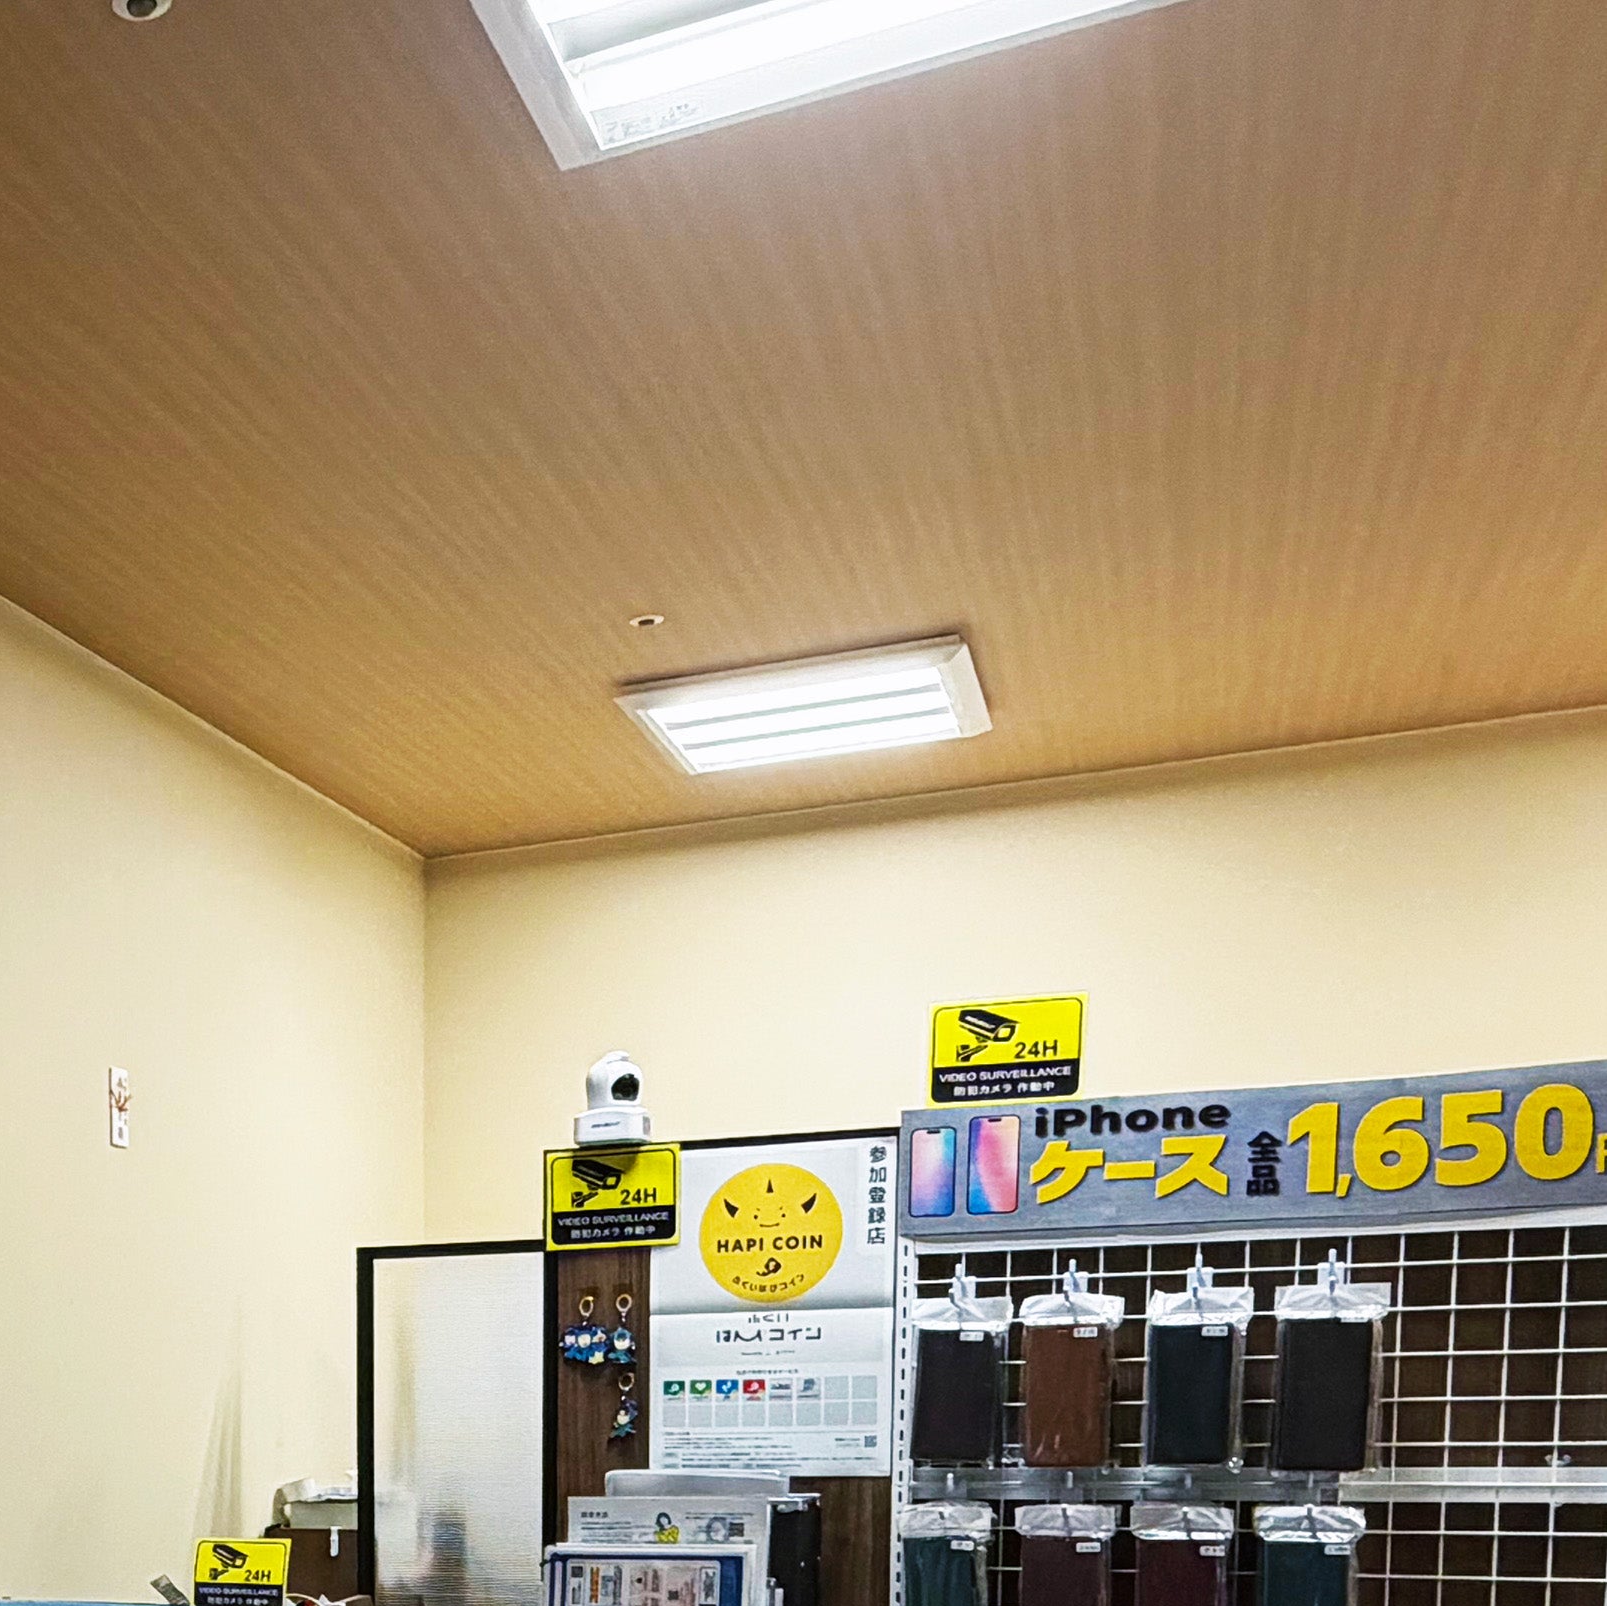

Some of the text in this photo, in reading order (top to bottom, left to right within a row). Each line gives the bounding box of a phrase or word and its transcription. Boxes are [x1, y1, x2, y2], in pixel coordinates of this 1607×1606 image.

[1015, 1039, 1058, 1059] 24H
[939, 1065, 1071, 1083] VIDEO SURVEILLANCE
[1035, 1101, 1232, 1138] iPhone
[1030, 1135, 1229, 1205] ケース
[1246, 1131, 1281, 1198] 全品
[620, 1188, 657, 1206] 24H
[868, 1145, 887, 1246] 参加登録店
[557, 1211, 669, 1227] VIDEO SURVEILLANCE
[717, 1234, 824, 1255] HAPI COIN
[244, 1569, 272, 1583] 24H
